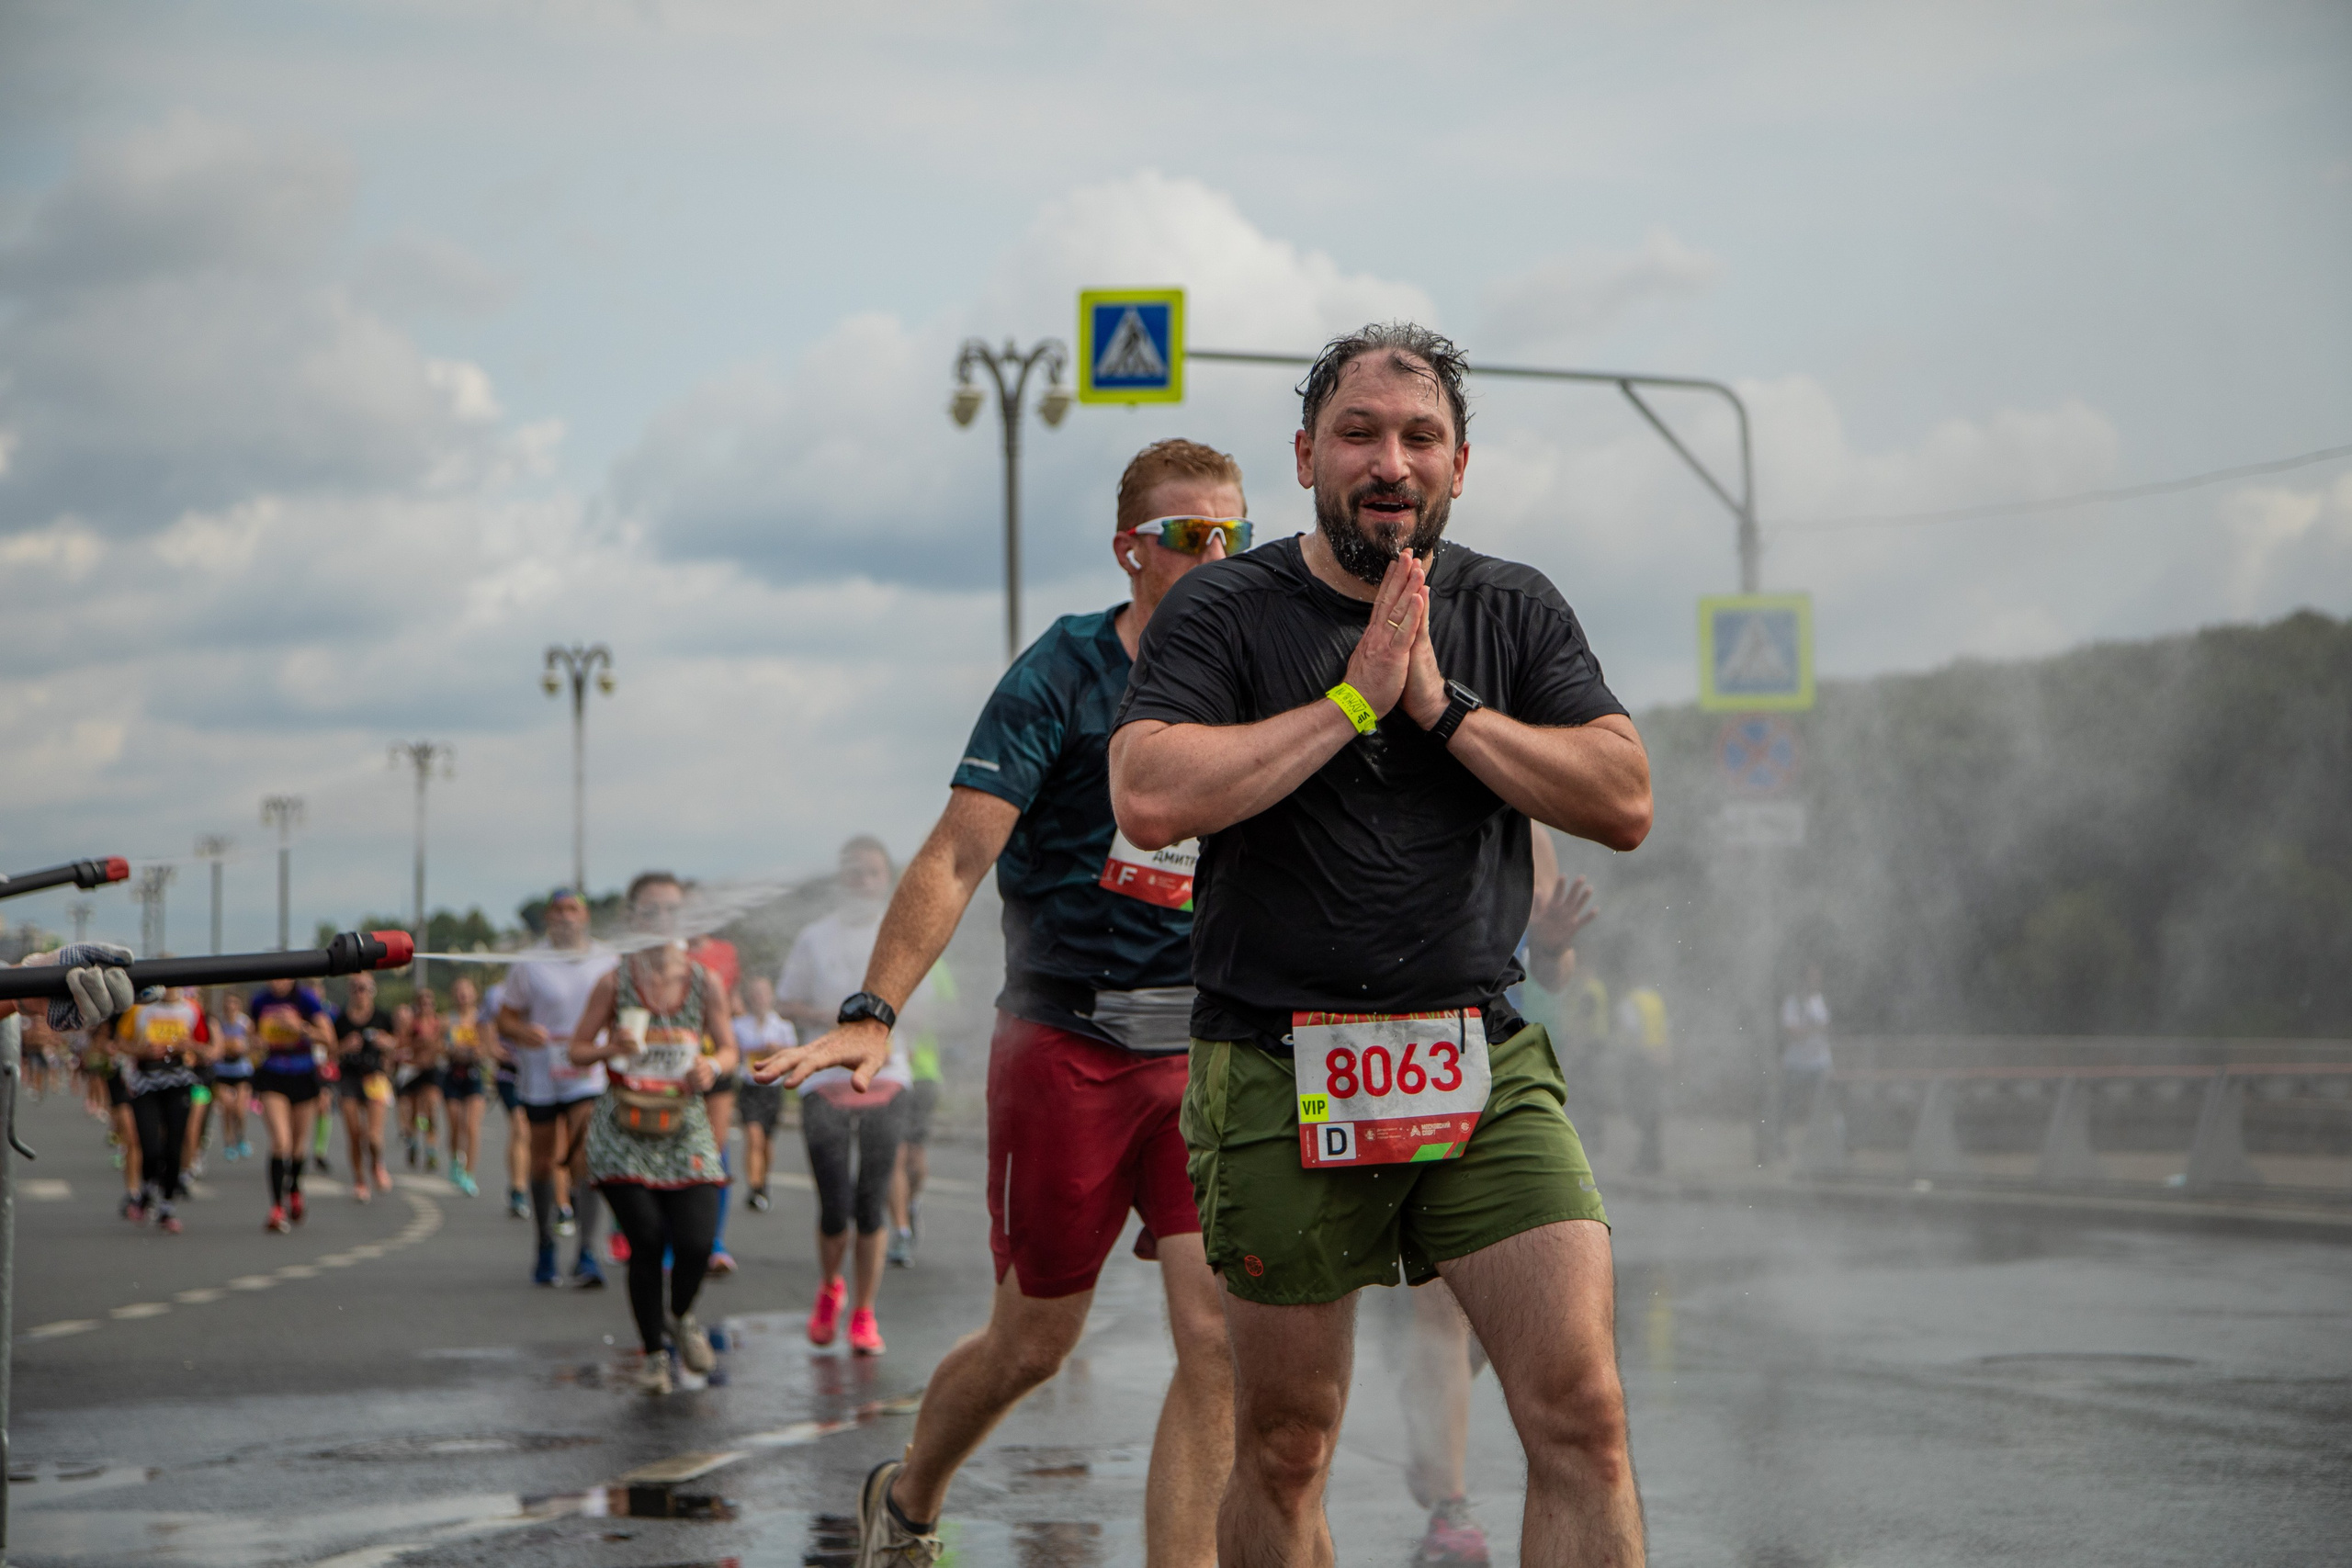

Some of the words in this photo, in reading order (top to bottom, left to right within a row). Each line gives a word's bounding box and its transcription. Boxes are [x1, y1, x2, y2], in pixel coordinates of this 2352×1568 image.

[1357, 711, 1370, 724] VIP
[1117, 865, 1138, 886] F
[1326, 1041, 1463, 1100] 8063
[1302, 1100, 1326, 1115] VIP
[1326, 1127, 1348, 1156] D
